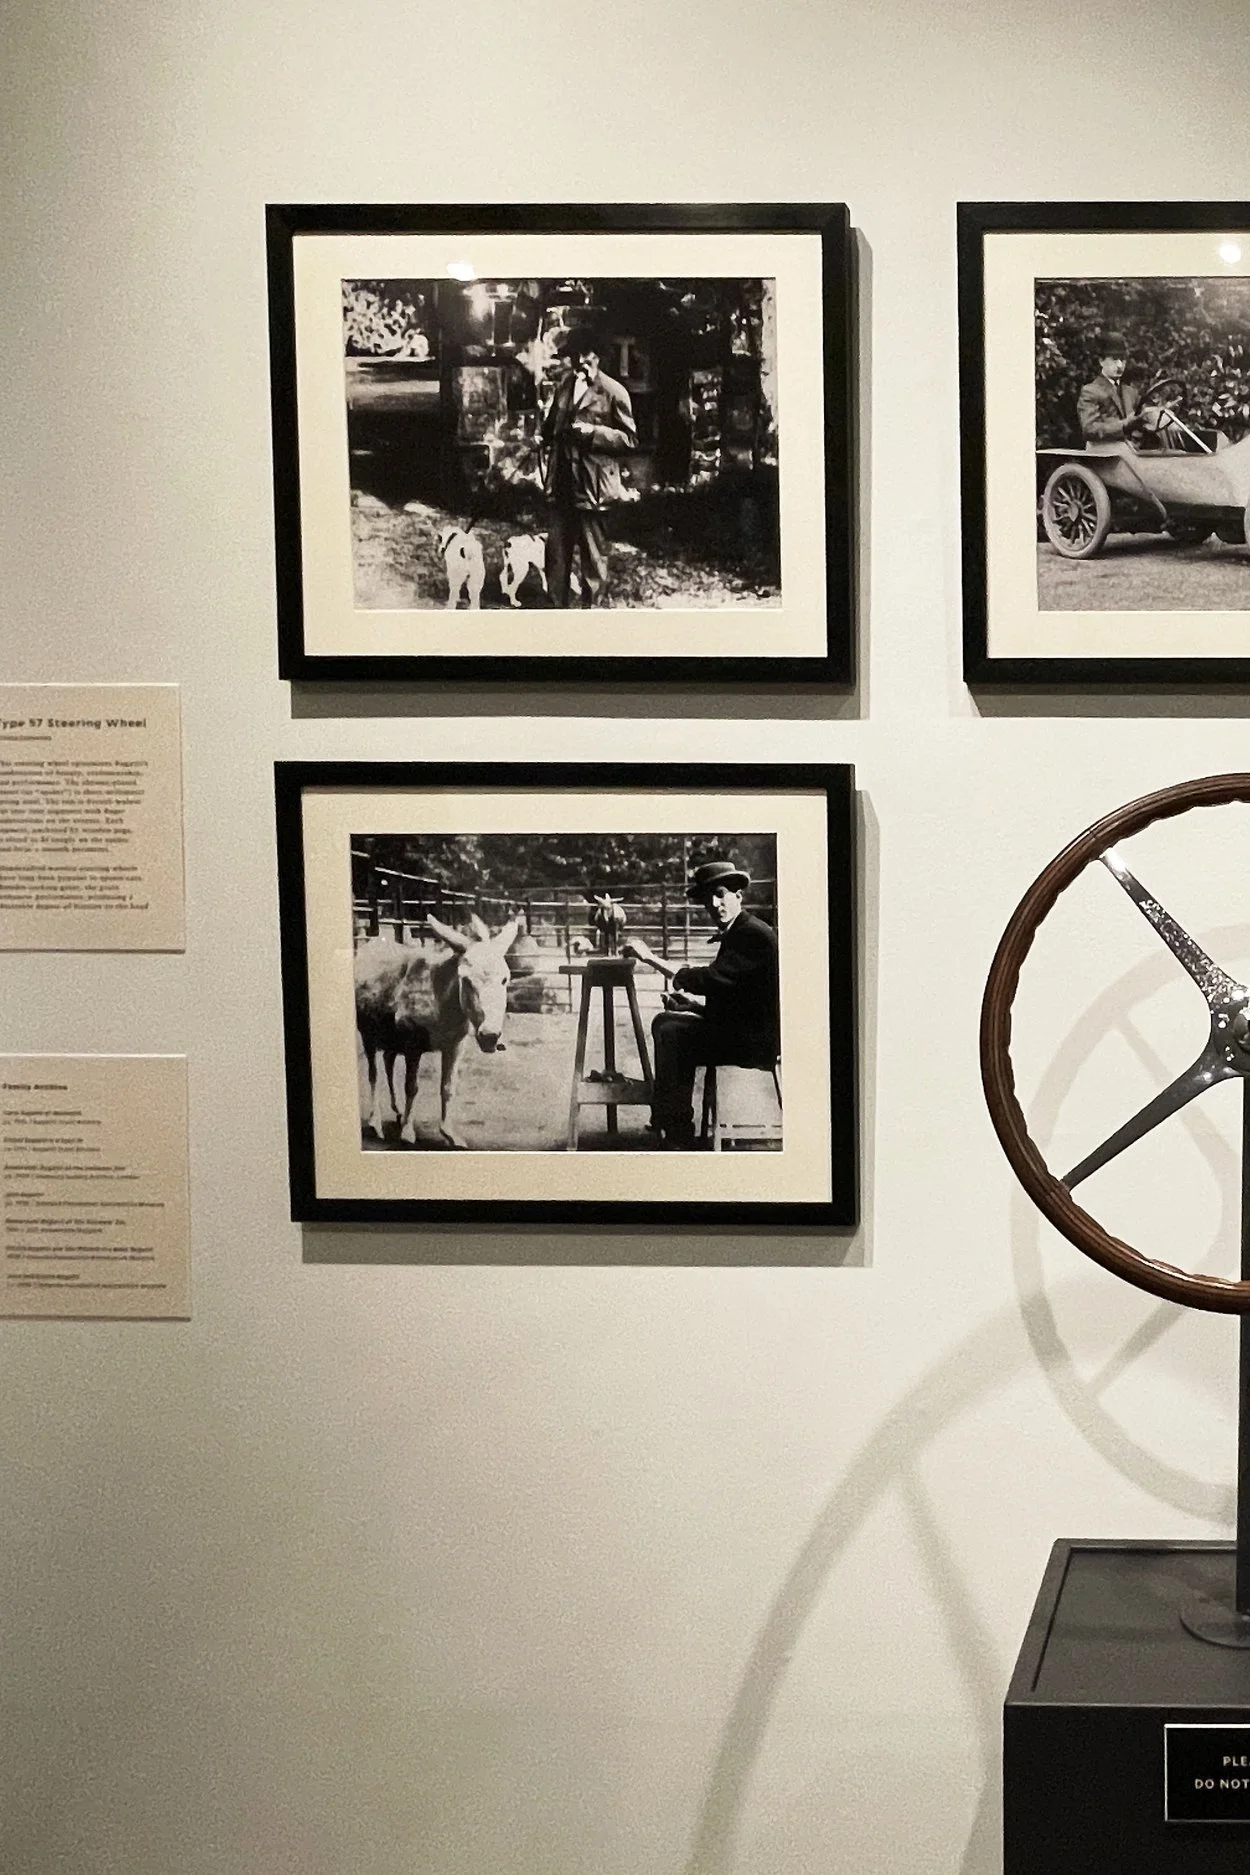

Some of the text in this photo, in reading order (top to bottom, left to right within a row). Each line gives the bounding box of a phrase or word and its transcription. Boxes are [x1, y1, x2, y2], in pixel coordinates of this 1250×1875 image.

[29, 718, 43, 728] 57
[47, 718, 102, 730] Steering
[106, 718, 147, 729] Wheel
[1194, 1778, 1215, 1790] DO
[1219, 1778, 1250, 1790] NOT
